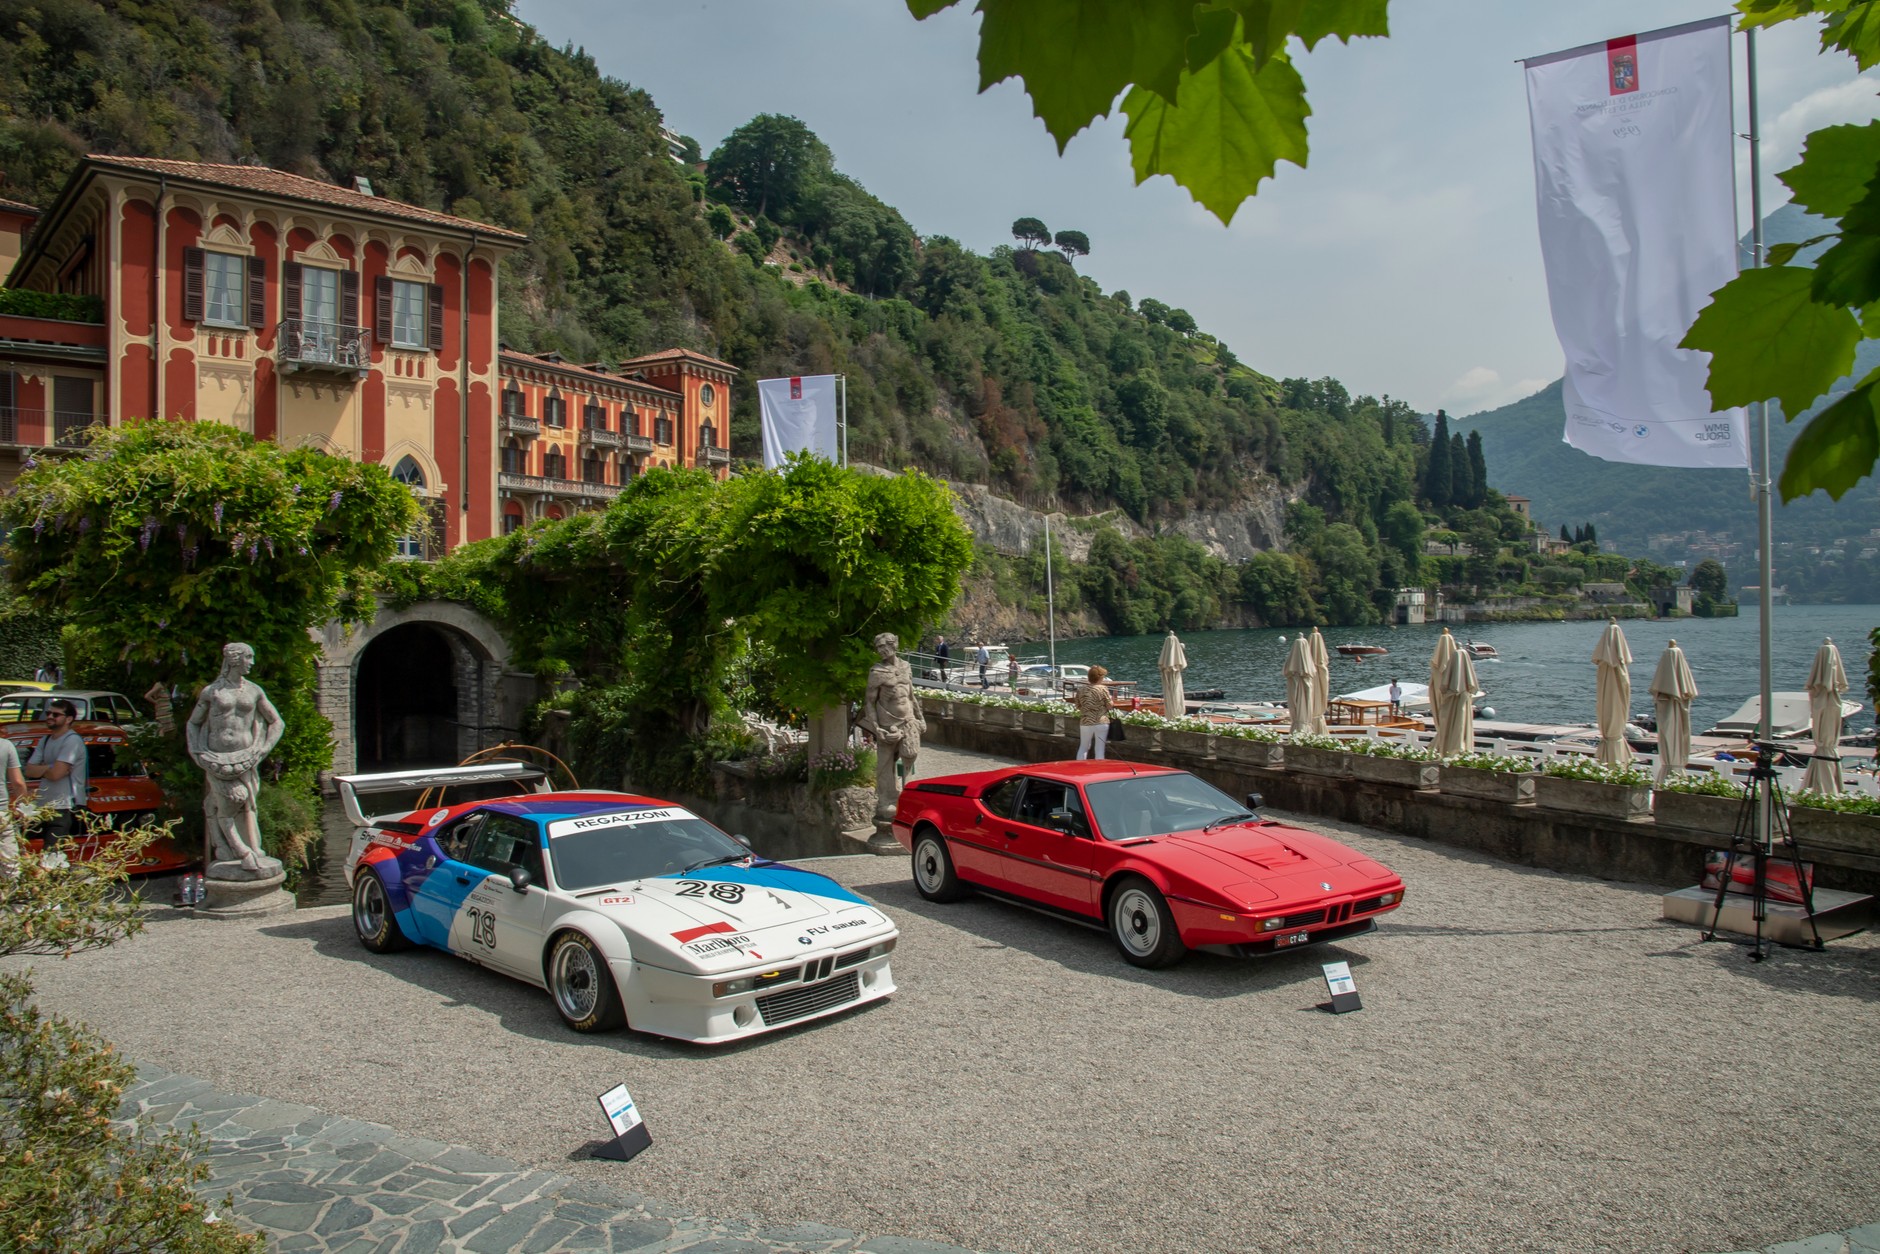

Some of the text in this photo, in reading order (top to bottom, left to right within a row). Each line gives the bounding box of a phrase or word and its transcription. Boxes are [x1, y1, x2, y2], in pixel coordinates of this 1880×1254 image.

[574, 810, 671, 829] REGAZZONI
[603, 896, 631, 904] GT2
[674, 880, 746, 905] 28
[466, 906, 497, 949] 28
[806, 919, 867, 936] FLY saudia
[689, 934, 751, 955] Marlboro
[575, 1013, 597, 1030] EAGLE
